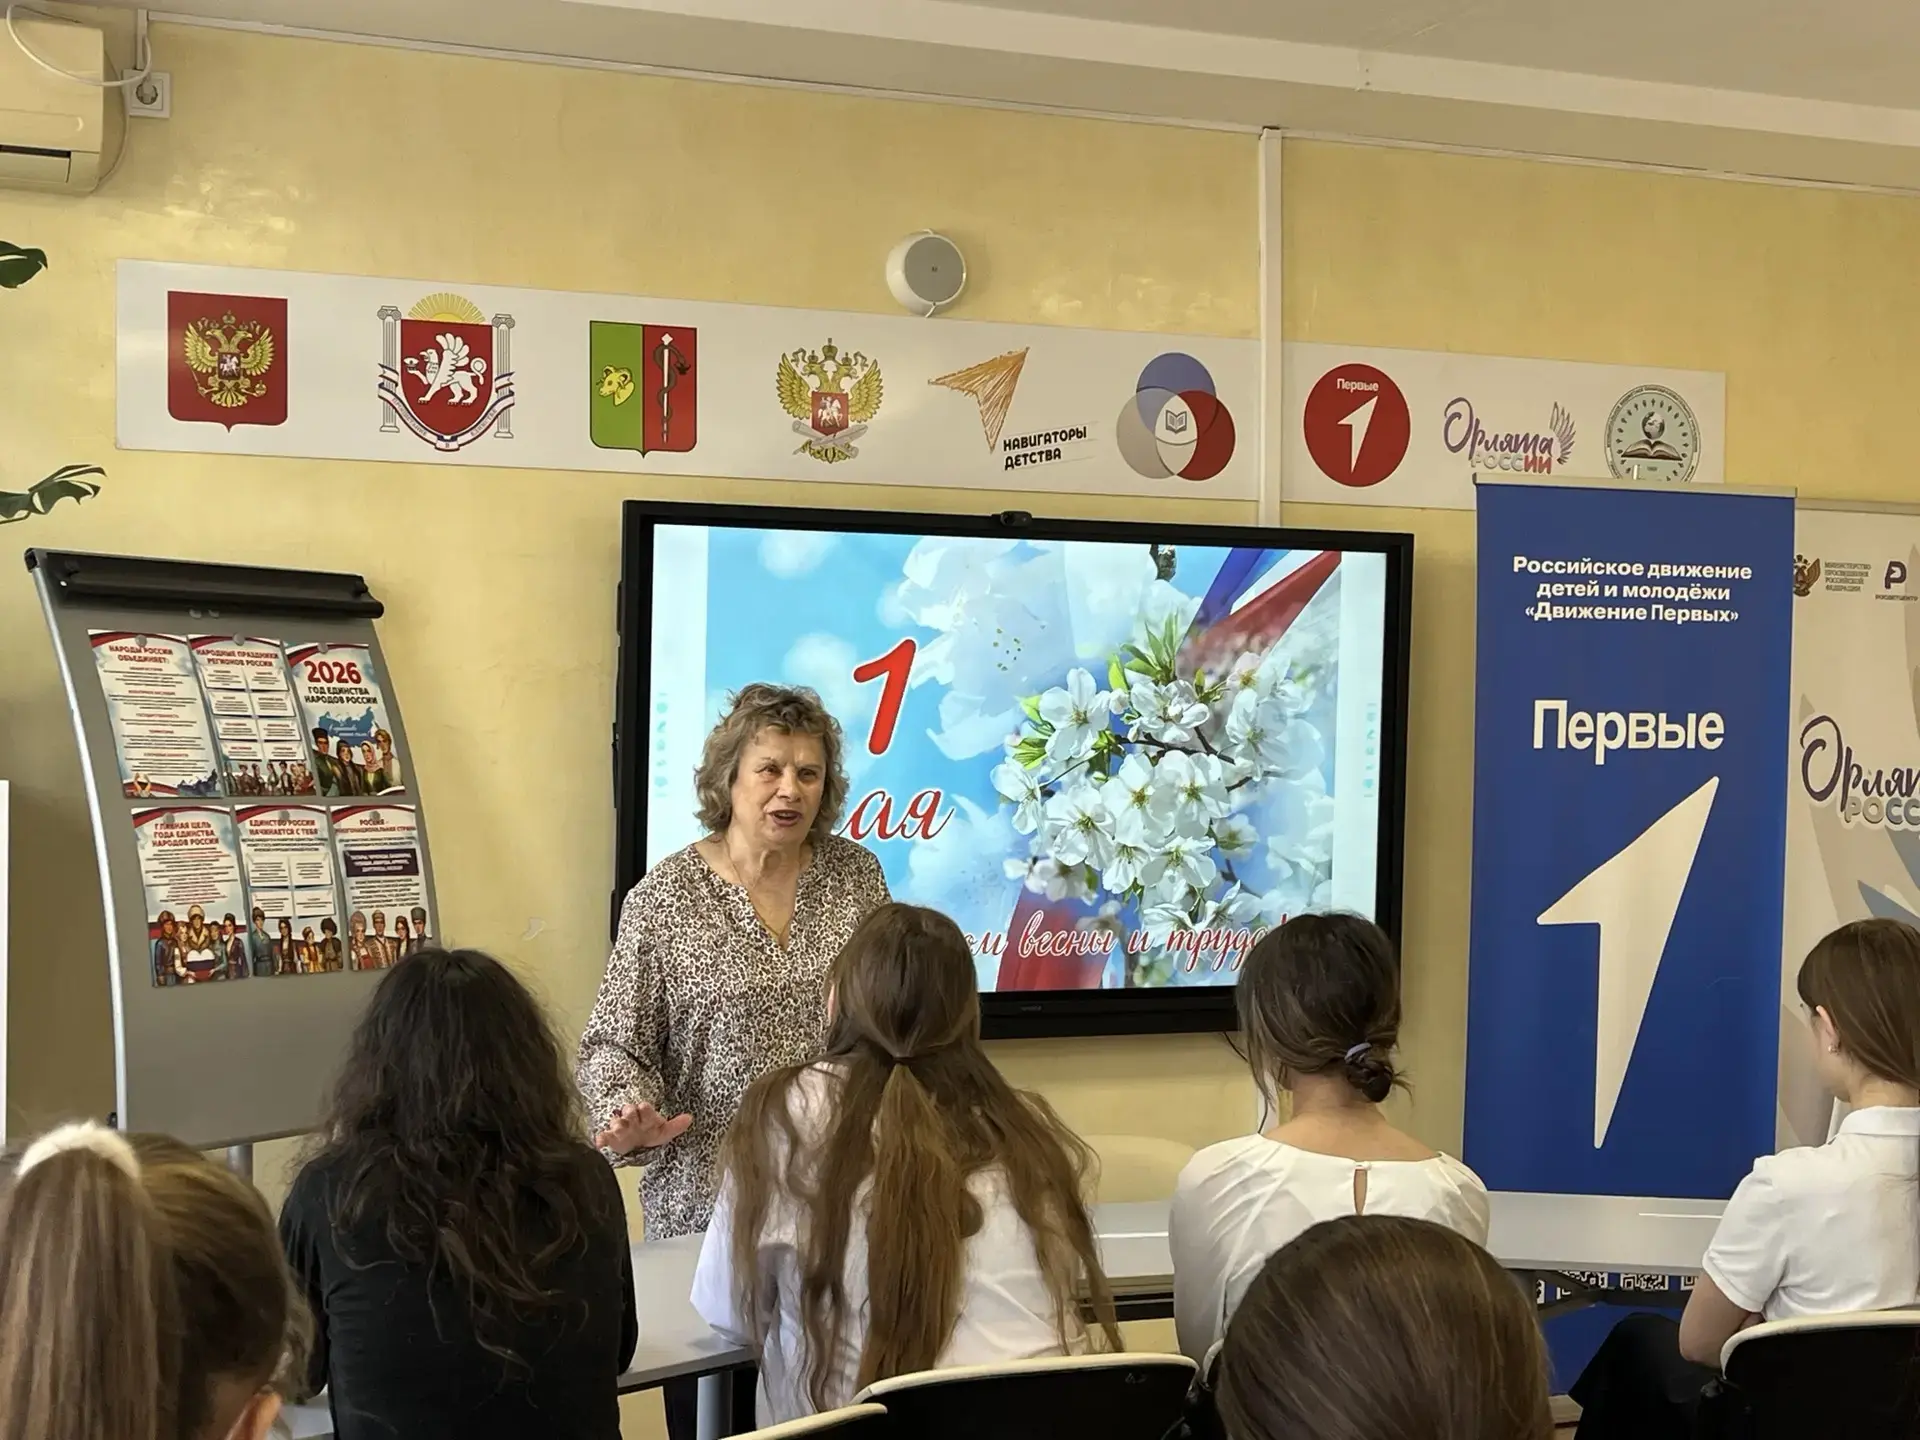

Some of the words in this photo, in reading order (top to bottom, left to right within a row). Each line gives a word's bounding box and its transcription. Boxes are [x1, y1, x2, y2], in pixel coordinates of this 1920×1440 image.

[1336, 378, 1380, 394] Первые
[1003, 426, 1087, 452] НАВИГАТОРЫ
[1443, 396, 1554, 461] Орлята
[1004, 447, 1062, 471] ДЕТСТВА
[1470, 452, 1552, 475] РОССИИ
[1513, 556, 1644, 577] Российское
[1647, 563, 1753, 580] движение
[1536, 580, 1599, 598] детей
[1603, 584, 1618, 598] и
[1622, 583, 1731, 602] молодёжи
[1525, 601, 1648, 621] «Движение
[1650, 603, 1740, 625] Первых»
[303, 660, 362, 685] 2026
[304, 695, 345, 705] НАРОДОВ
[345, 696, 378, 705] РОССИИ
[308, 686, 327, 695] ГОД
[327, 686, 370, 696] ЕДИНСТВА
[853, 638, 917, 755] 1
[1532, 699, 1725, 765] Первые
[838, 790, 955, 841] ая
[1844, 796, 1920, 826] РОСС
[153, 831, 174, 839] ГОДА
[1017, 909, 1120, 959] весны
[1127, 927, 1156, 957] и
